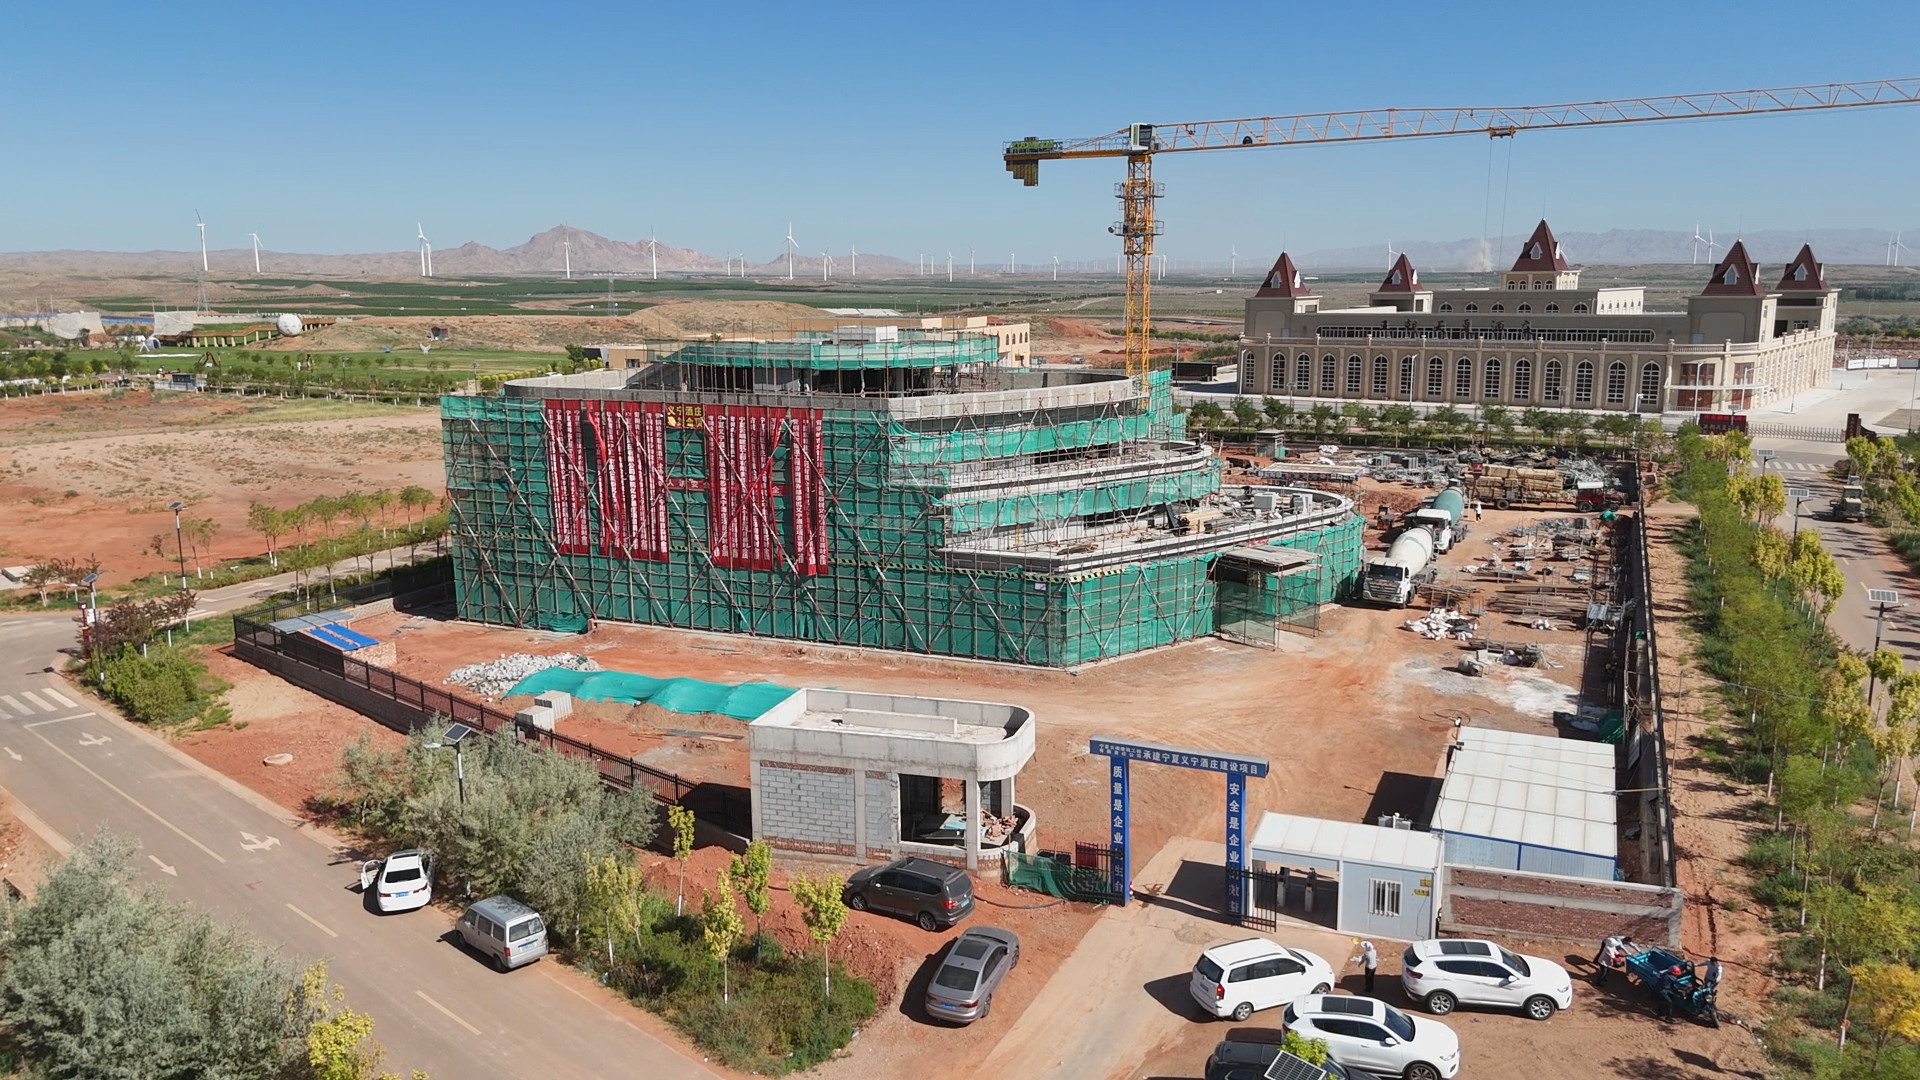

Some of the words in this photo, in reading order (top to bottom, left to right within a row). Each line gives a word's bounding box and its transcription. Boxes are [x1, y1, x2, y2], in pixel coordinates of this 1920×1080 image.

[1142, 749, 1258, 775] 承建宁夏义宁酒庄建设项目
